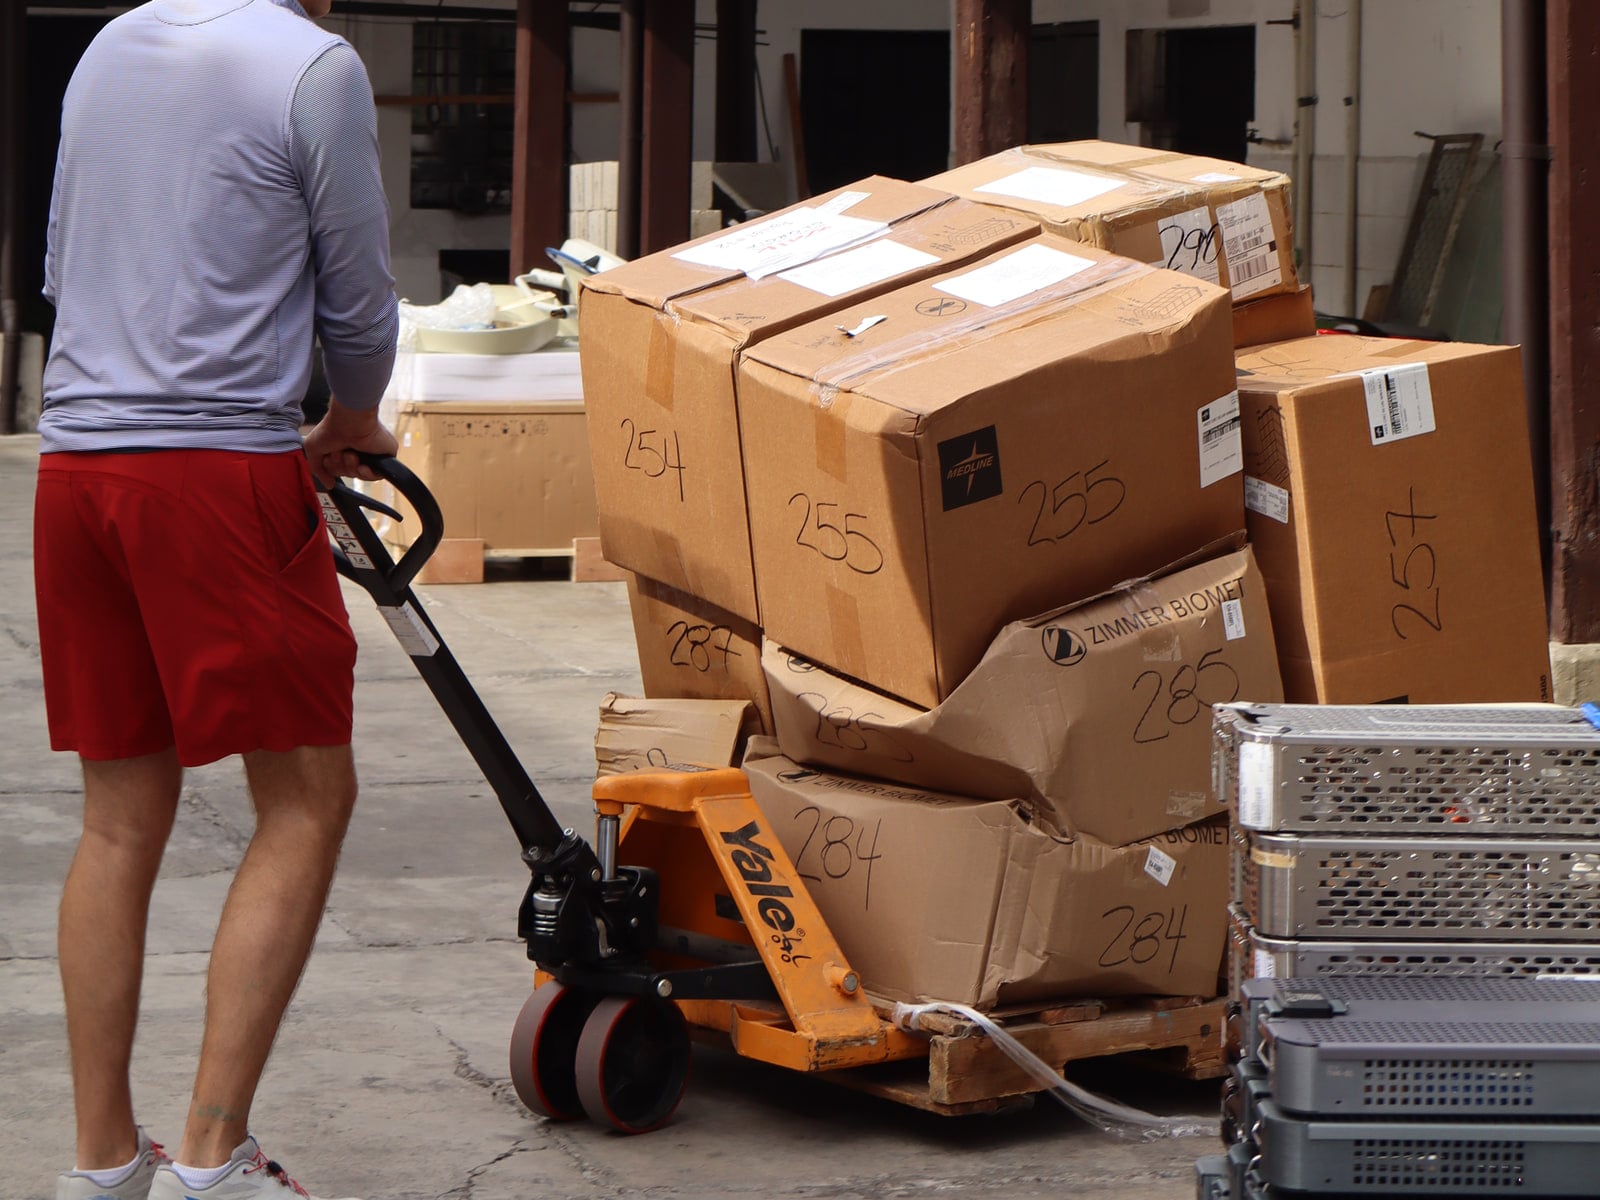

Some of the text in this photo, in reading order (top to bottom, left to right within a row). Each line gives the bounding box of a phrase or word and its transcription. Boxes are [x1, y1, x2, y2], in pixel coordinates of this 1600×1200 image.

[620, 418, 686, 503] 254
[946, 455, 994, 480] MEDLINE
[787, 492, 884, 575] 255
[1018, 459, 1126, 547] 255
[1385, 486, 1443, 641] 257
[666, 620, 742, 674] 287
[1084, 576, 1246, 645] ZIMMER BIOMET
[796, 691, 914, 763] 285
[1131, 648, 1240, 744] 285
[814, 777, 957, 806] ZIMMER BIOMET
[719, 820, 796, 933] Yale
[792, 806, 882, 911] 284
[1098, 903, 1187, 974] 284
